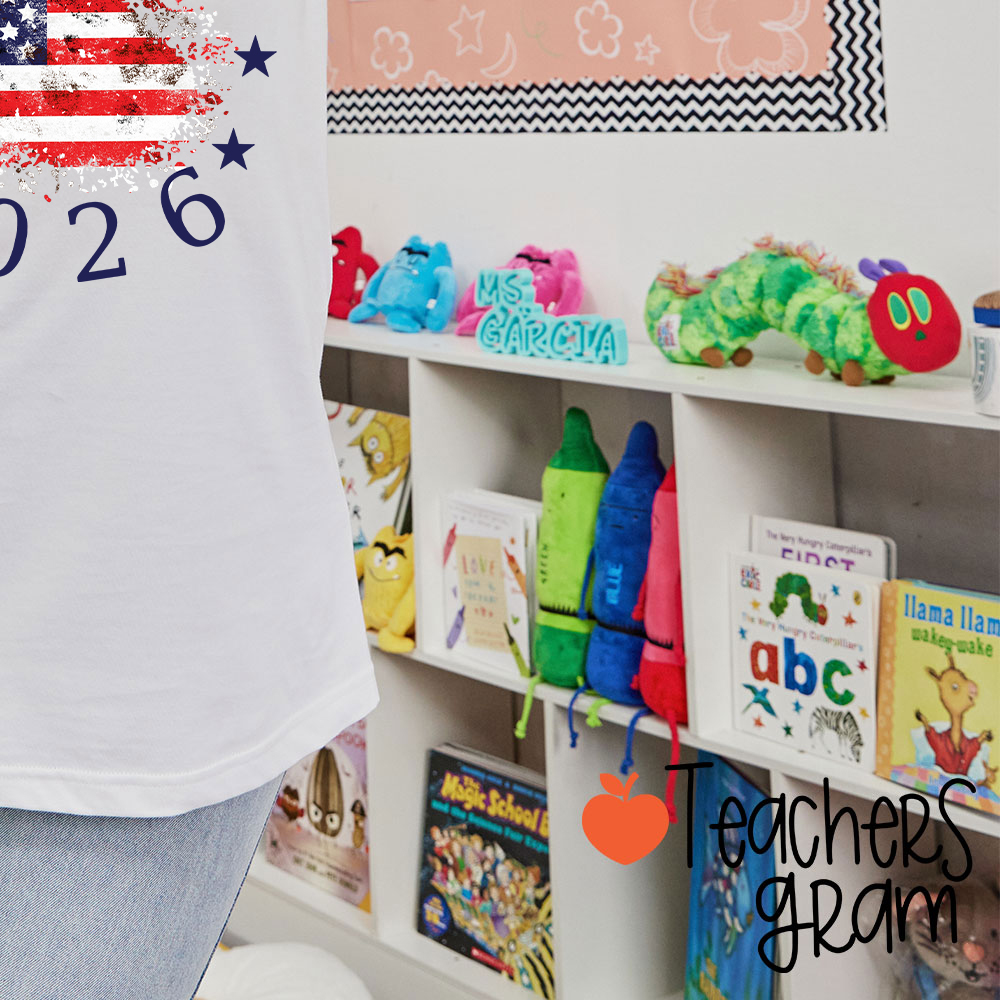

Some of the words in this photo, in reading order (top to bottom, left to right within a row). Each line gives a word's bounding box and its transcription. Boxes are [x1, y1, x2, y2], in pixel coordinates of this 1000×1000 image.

[479, 312, 618, 362] GARCIA
[904, 593, 954, 627] llama
[750, 637, 855, 706] abc
[441, 771, 487, 811] Magic
[487, 788, 541, 833] School
